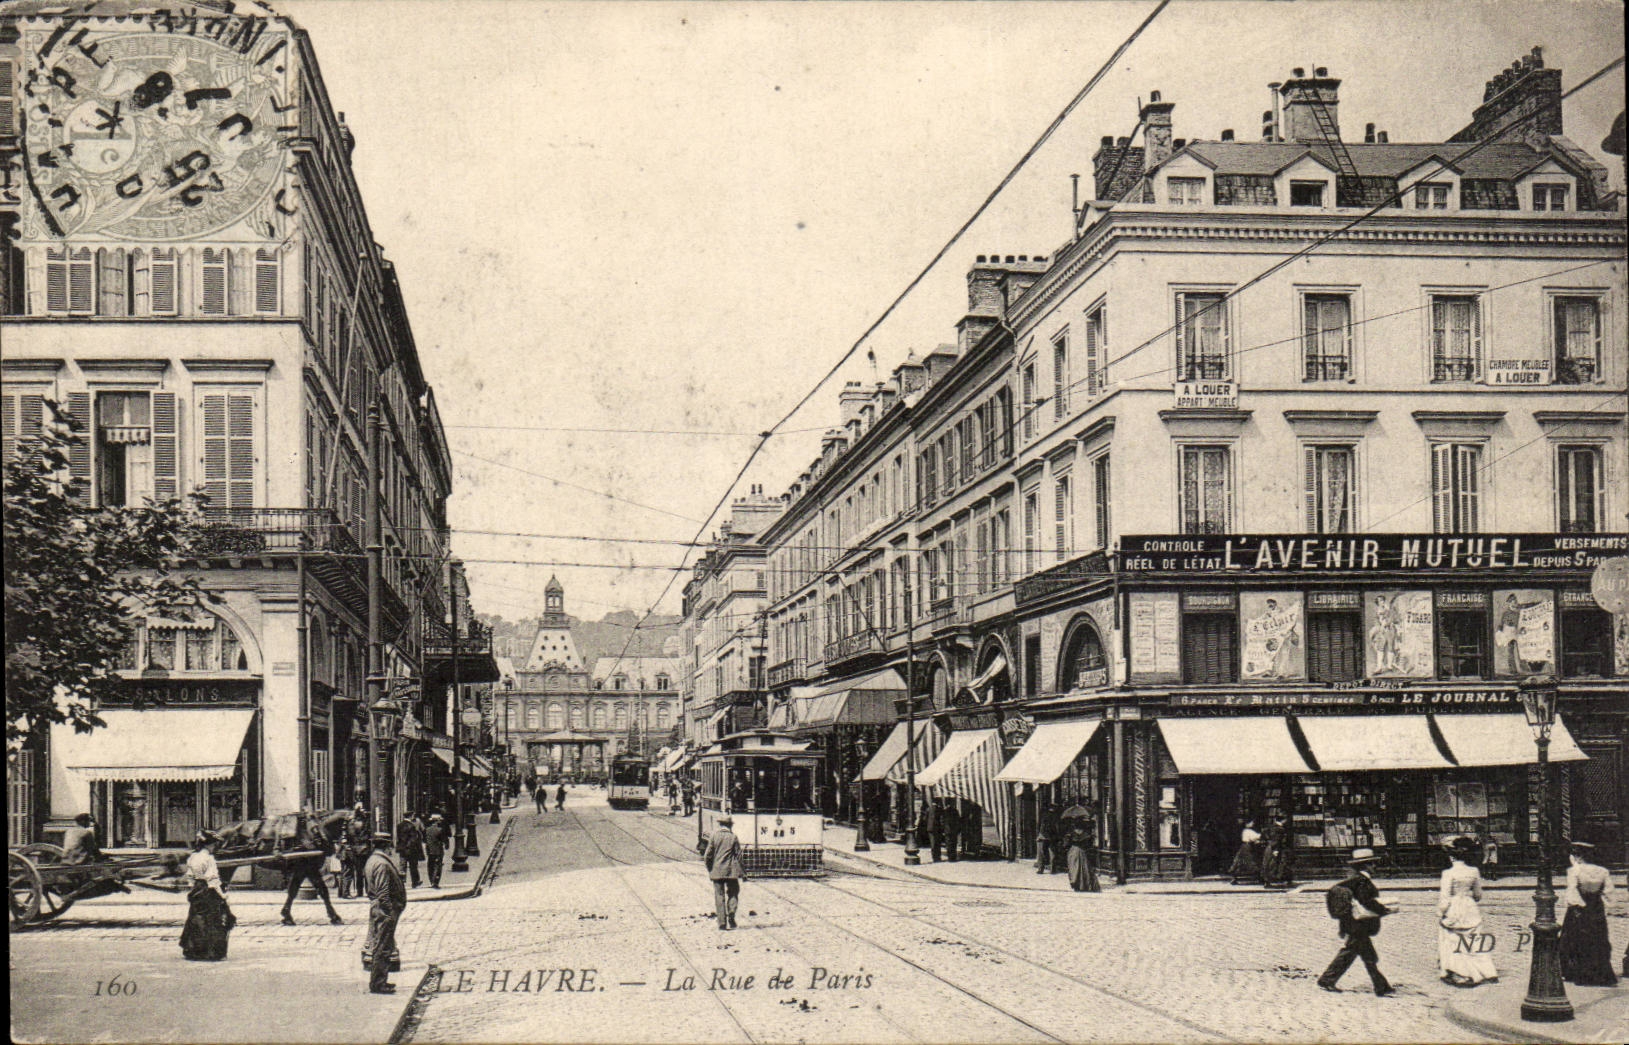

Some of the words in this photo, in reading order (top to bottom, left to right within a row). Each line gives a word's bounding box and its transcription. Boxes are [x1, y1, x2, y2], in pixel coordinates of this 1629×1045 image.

[1495, 372, 1502, 383] A
[1506, 372, 1540, 383] LOUER
[1184, 385, 1190, 395] A
[1195, 385, 1231, 395] LOUER
[1143, 541, 1205, 552] CONTROLE
[1554, 537, 1628, 550] VERSEMENTS
[1224, 537, 1380, 569] L'AVENIR
[1400, 538, 1529, 568] MUTUEL
[1125, 555, 1153, 570] RÉEL
[1162, 558, 1177, 569] DE
[1533, 556, 1572, 568] DEPUIS
[1251, 695, 1297, 705] Matin
[1402, 693, 1423, 703] LE
[1431, 692, 1510, 703] JOURNAL
